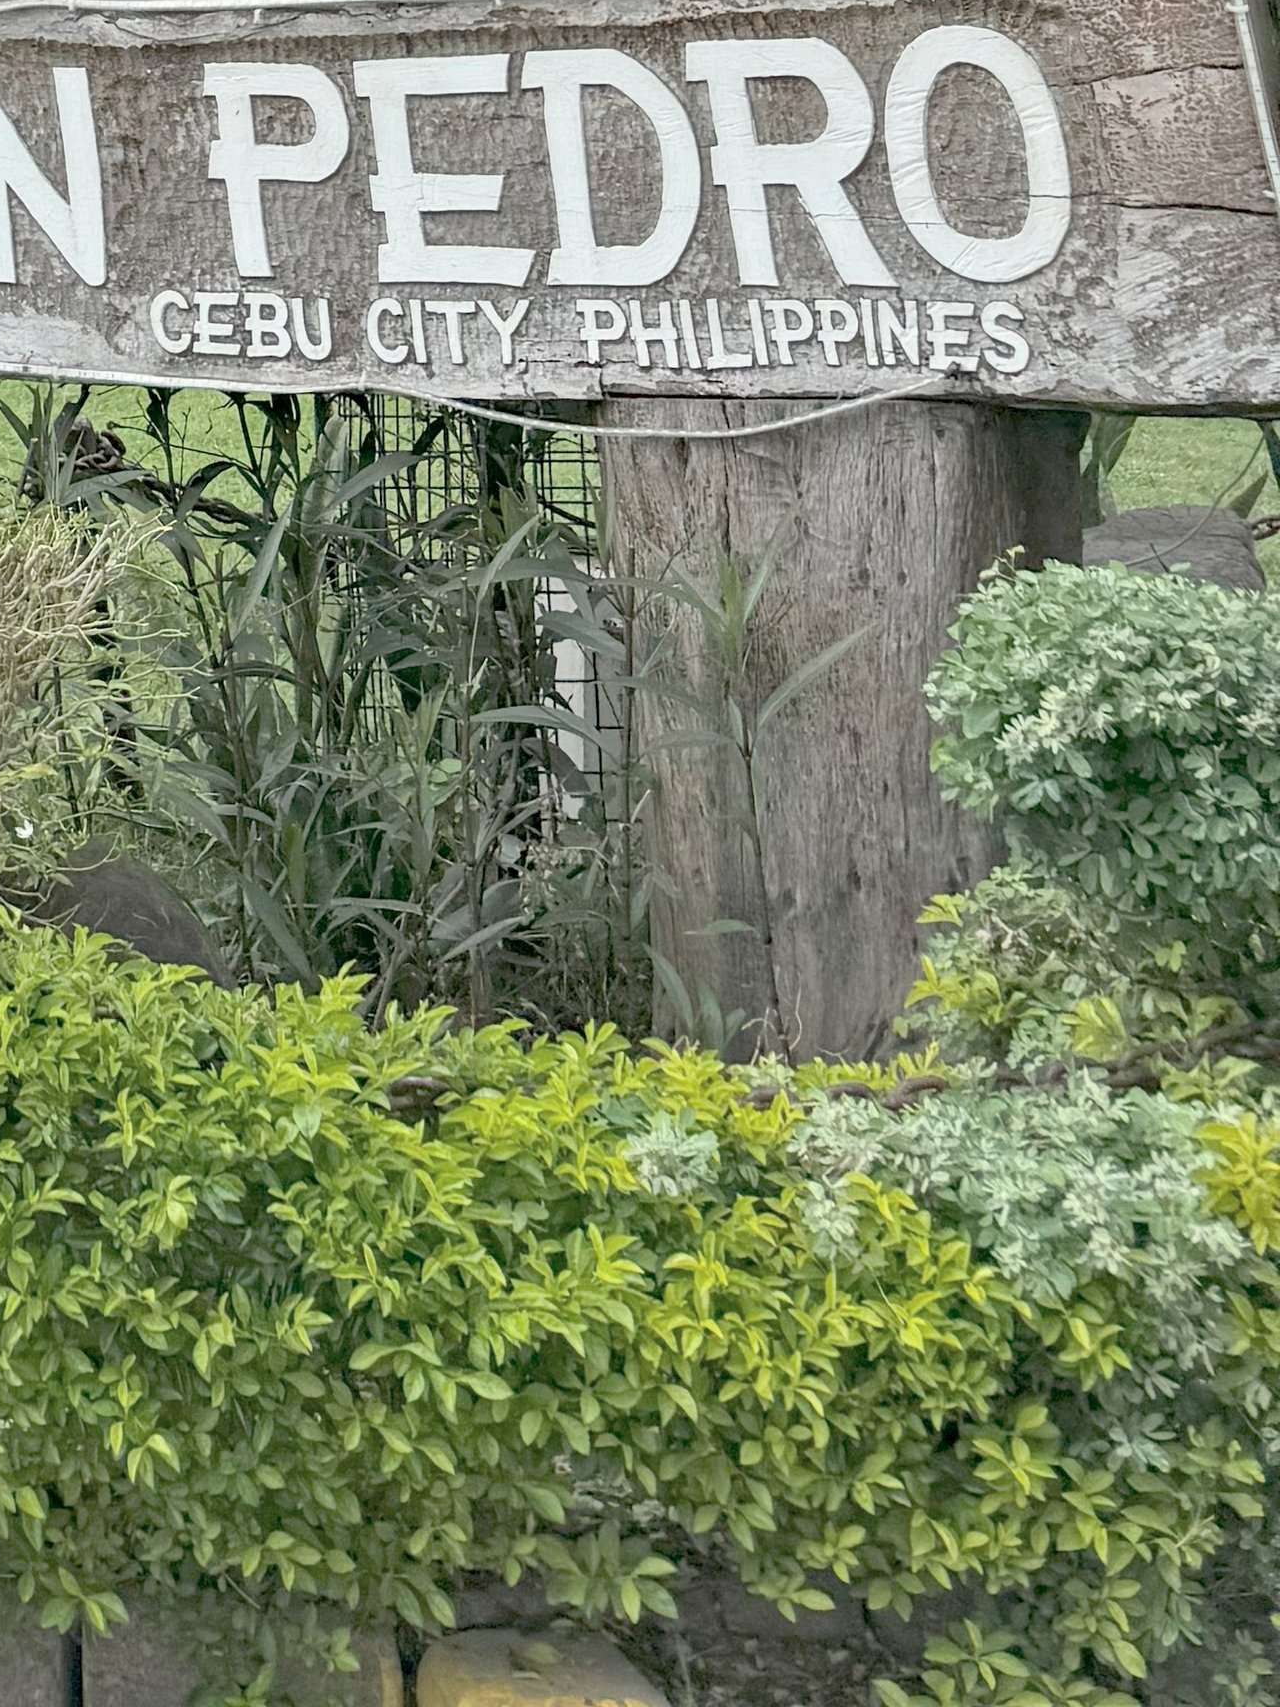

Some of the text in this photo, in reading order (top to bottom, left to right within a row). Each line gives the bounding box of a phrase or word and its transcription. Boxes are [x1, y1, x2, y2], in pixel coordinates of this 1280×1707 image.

[202, 24, 1073, 288] PEDRO
[148, 289, 1032, 374] CEBU CITY PHILIPPINES
